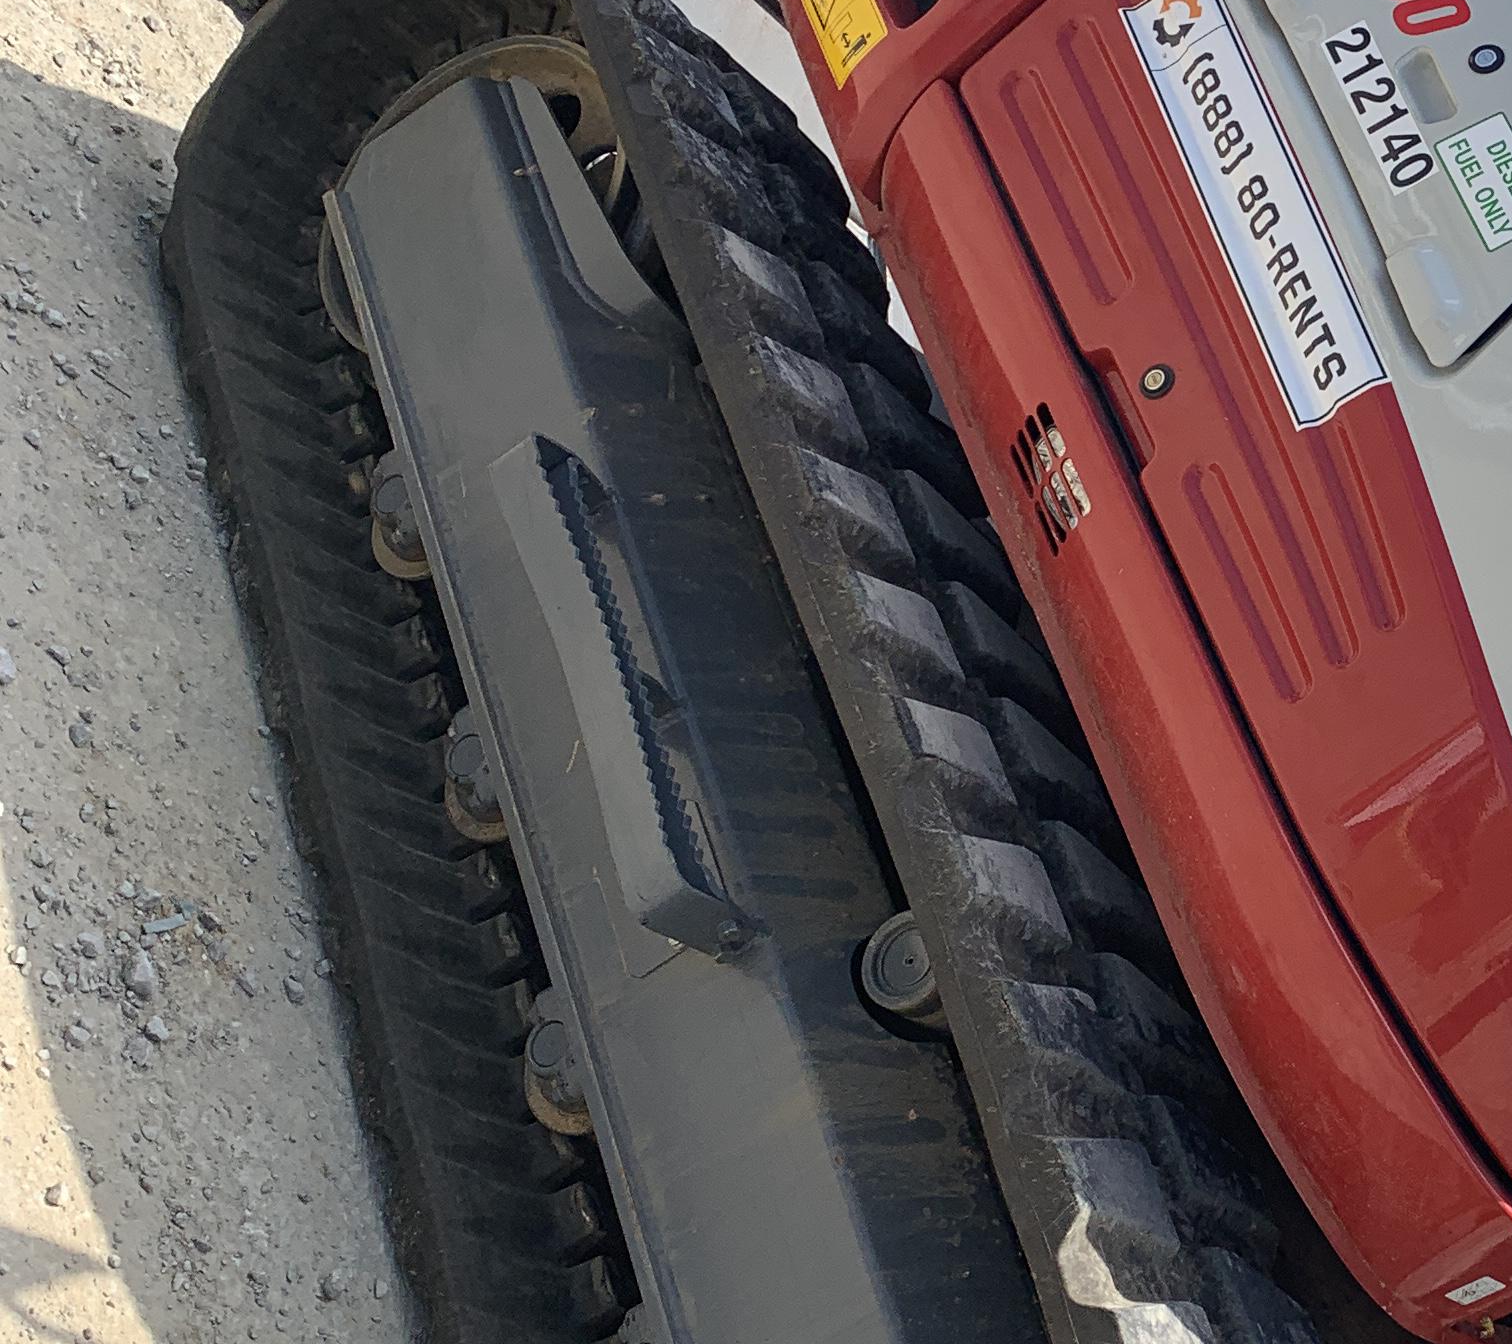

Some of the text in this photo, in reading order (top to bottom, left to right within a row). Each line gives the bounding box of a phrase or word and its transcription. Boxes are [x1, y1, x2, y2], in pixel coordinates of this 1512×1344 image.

[1325, 26, 1434, 188] 212140
[1448, 137, 1484, 188] FUEL
[1181, 52, 1347, 391] (888) 80-RENTS
